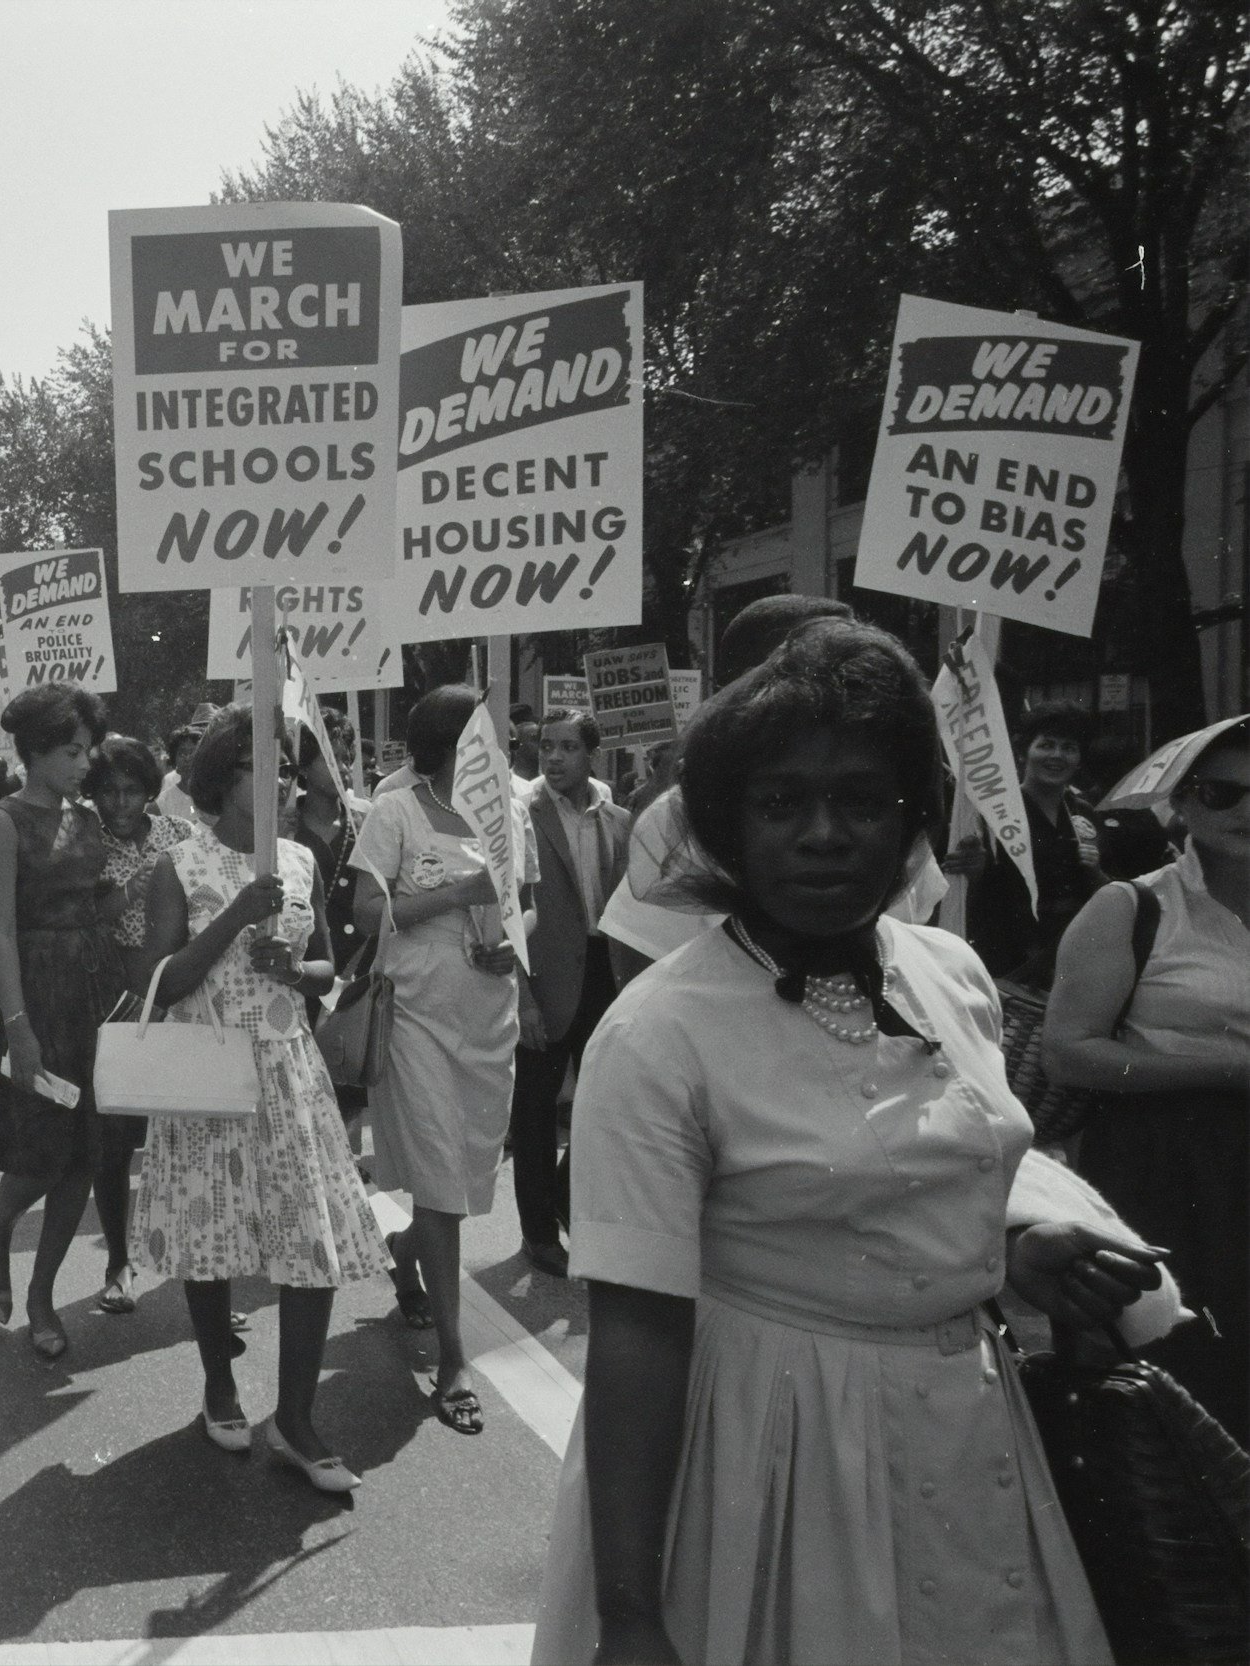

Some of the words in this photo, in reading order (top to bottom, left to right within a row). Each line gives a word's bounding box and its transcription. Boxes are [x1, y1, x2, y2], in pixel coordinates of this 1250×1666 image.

[221, 240, 294, 278] WE
[152, 282, 361, 335] MARCH
[219, 339, 299, 363] FOR
[460, 316, 550, 384] WE
[971, 340, 1059, 380] WE
[136, 381, 379, 432] INTEGRATED
[399, 347, 623, 456] DEMAND
[905, 382, 1113, 425] DEMAND
[137, 442, 376, 491] SCHOOLS
[421, 452, 609, 505] DECENT
[906, 443, 979, 485] AN
[996, 458, 1097, 509] END
[156, 494, 366, 565] NOW!
[403, 506, 627, 561] HOUSING
[905, 484, 966, 526] TO
[980, 499, 1087, 553] BIAS
[33, 558, 69, 585] WE
[419, 544, 616, 616] NOW!
[896, 531, 1082, 602] NOW!
[10, 572, 97, 615] DEMAND
[239, 586, 364, 613] RGHTS
[19, 616, 50, 631] AN
[55, 613, 94, 628] END
[37, 633, 83, 649] POLICE
[25, 646, 93, 663] BRUTALITY
[26, 654, 105, 686] NOW!
[551, 689, 591, 699] MARCH
[592, 665, 642, 689] JOBS
[594, 684, 668, 711] FREEDOM
[454, 733, 510, 871] FREEDOM
[992, 803, 1008, 821] IN
